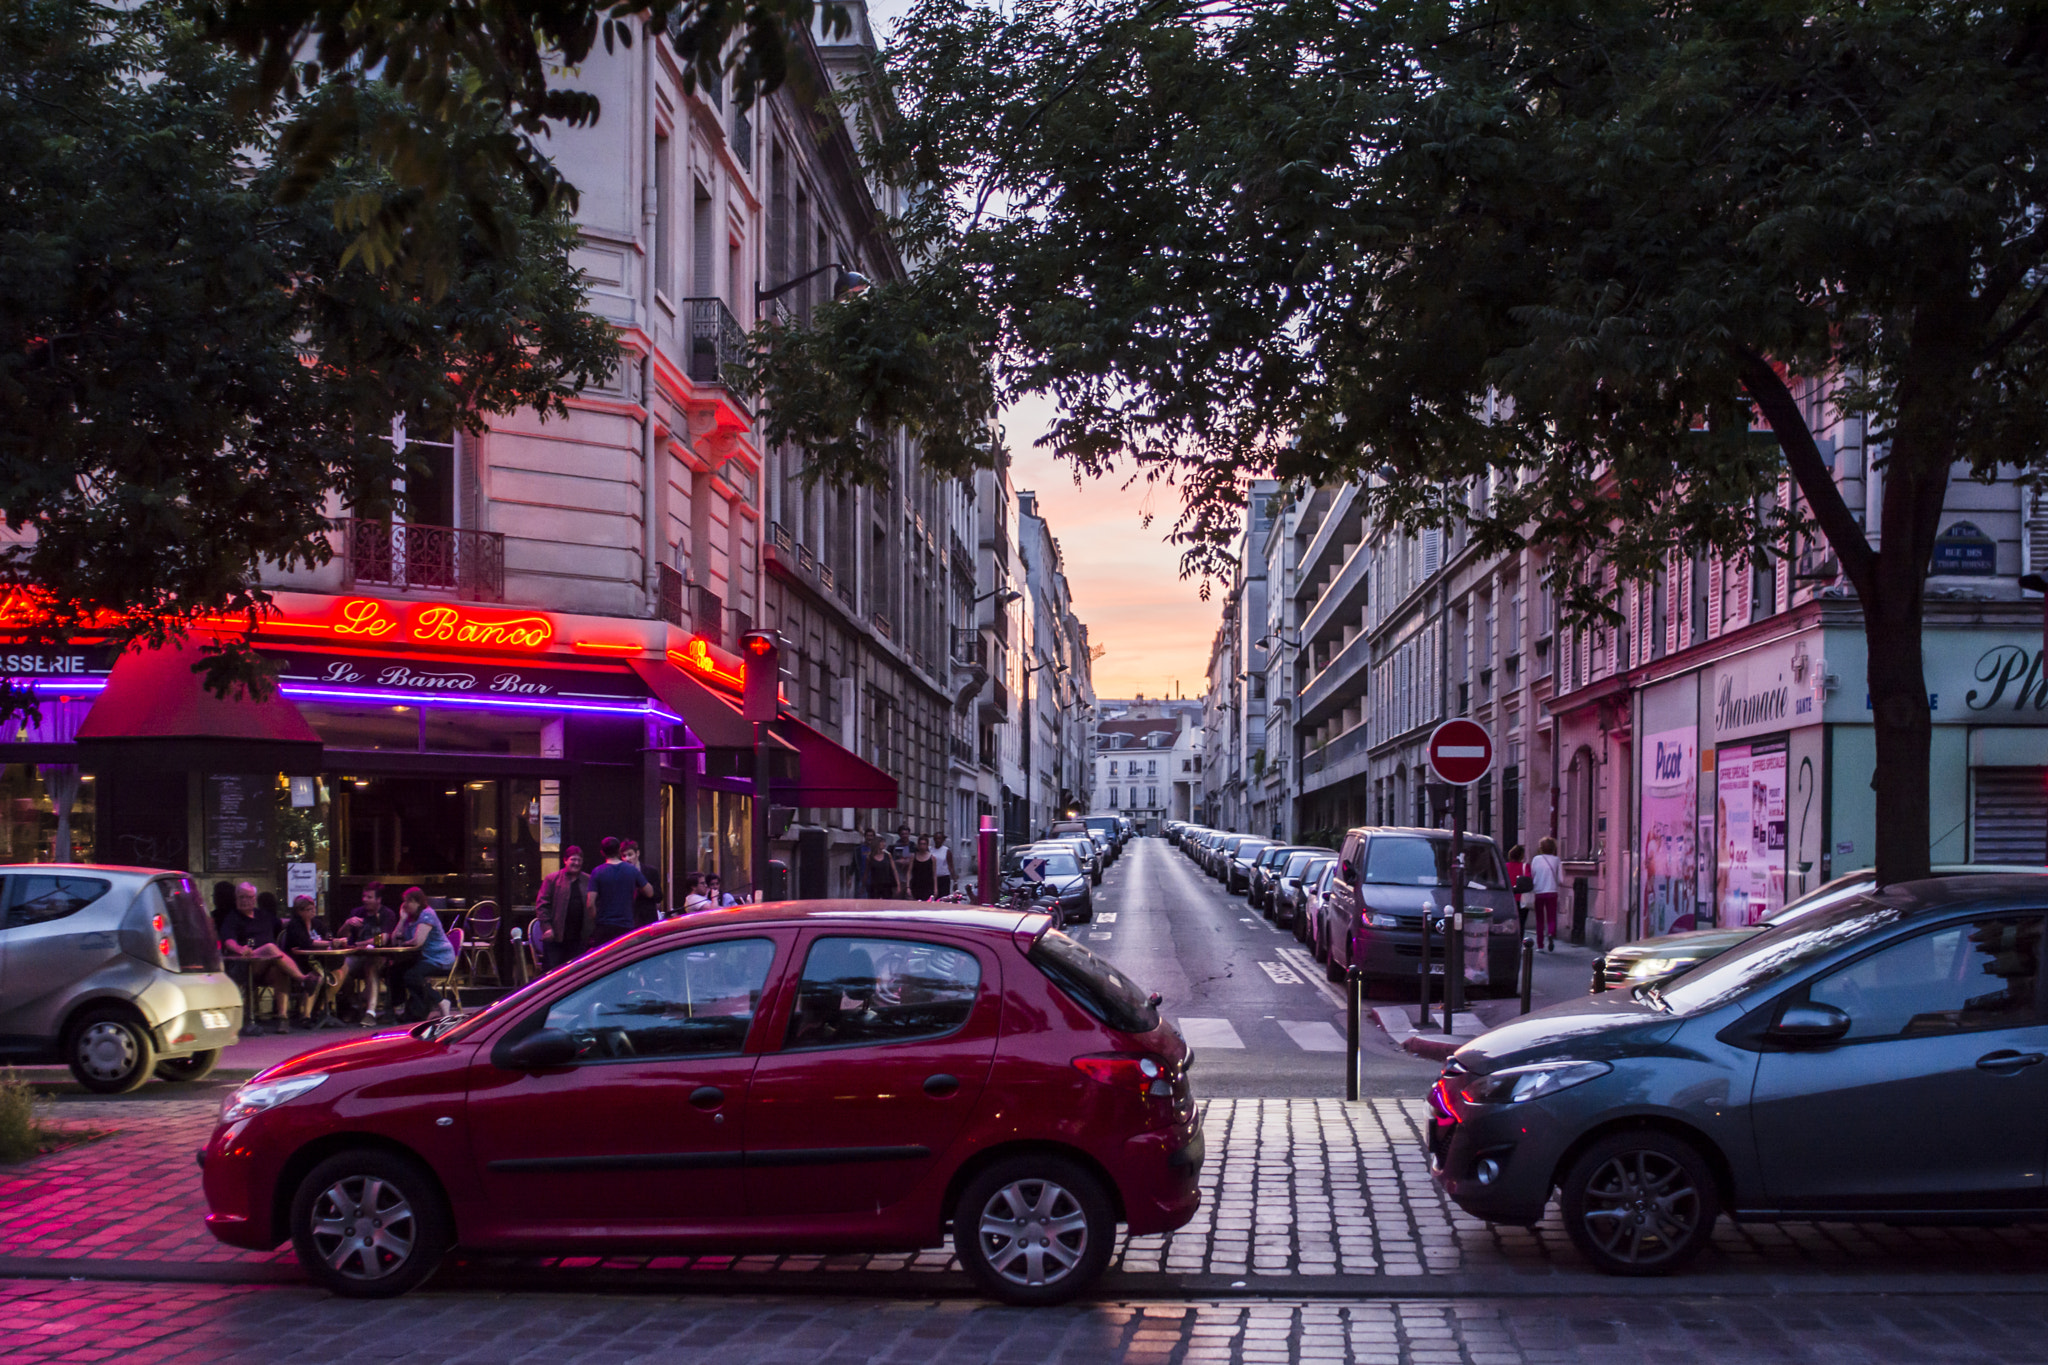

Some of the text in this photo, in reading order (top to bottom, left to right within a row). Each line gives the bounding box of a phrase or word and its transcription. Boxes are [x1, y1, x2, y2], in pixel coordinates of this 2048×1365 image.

[1945, 548, 1982, 557] RUE DES
[333, 600, 552, 647] Le Banco
[321, 661, 554, 695] Le Banco Bar
[1715, 672, 1788, 732] Pharmacie
[1655, 741, 1682, 780] Picot
